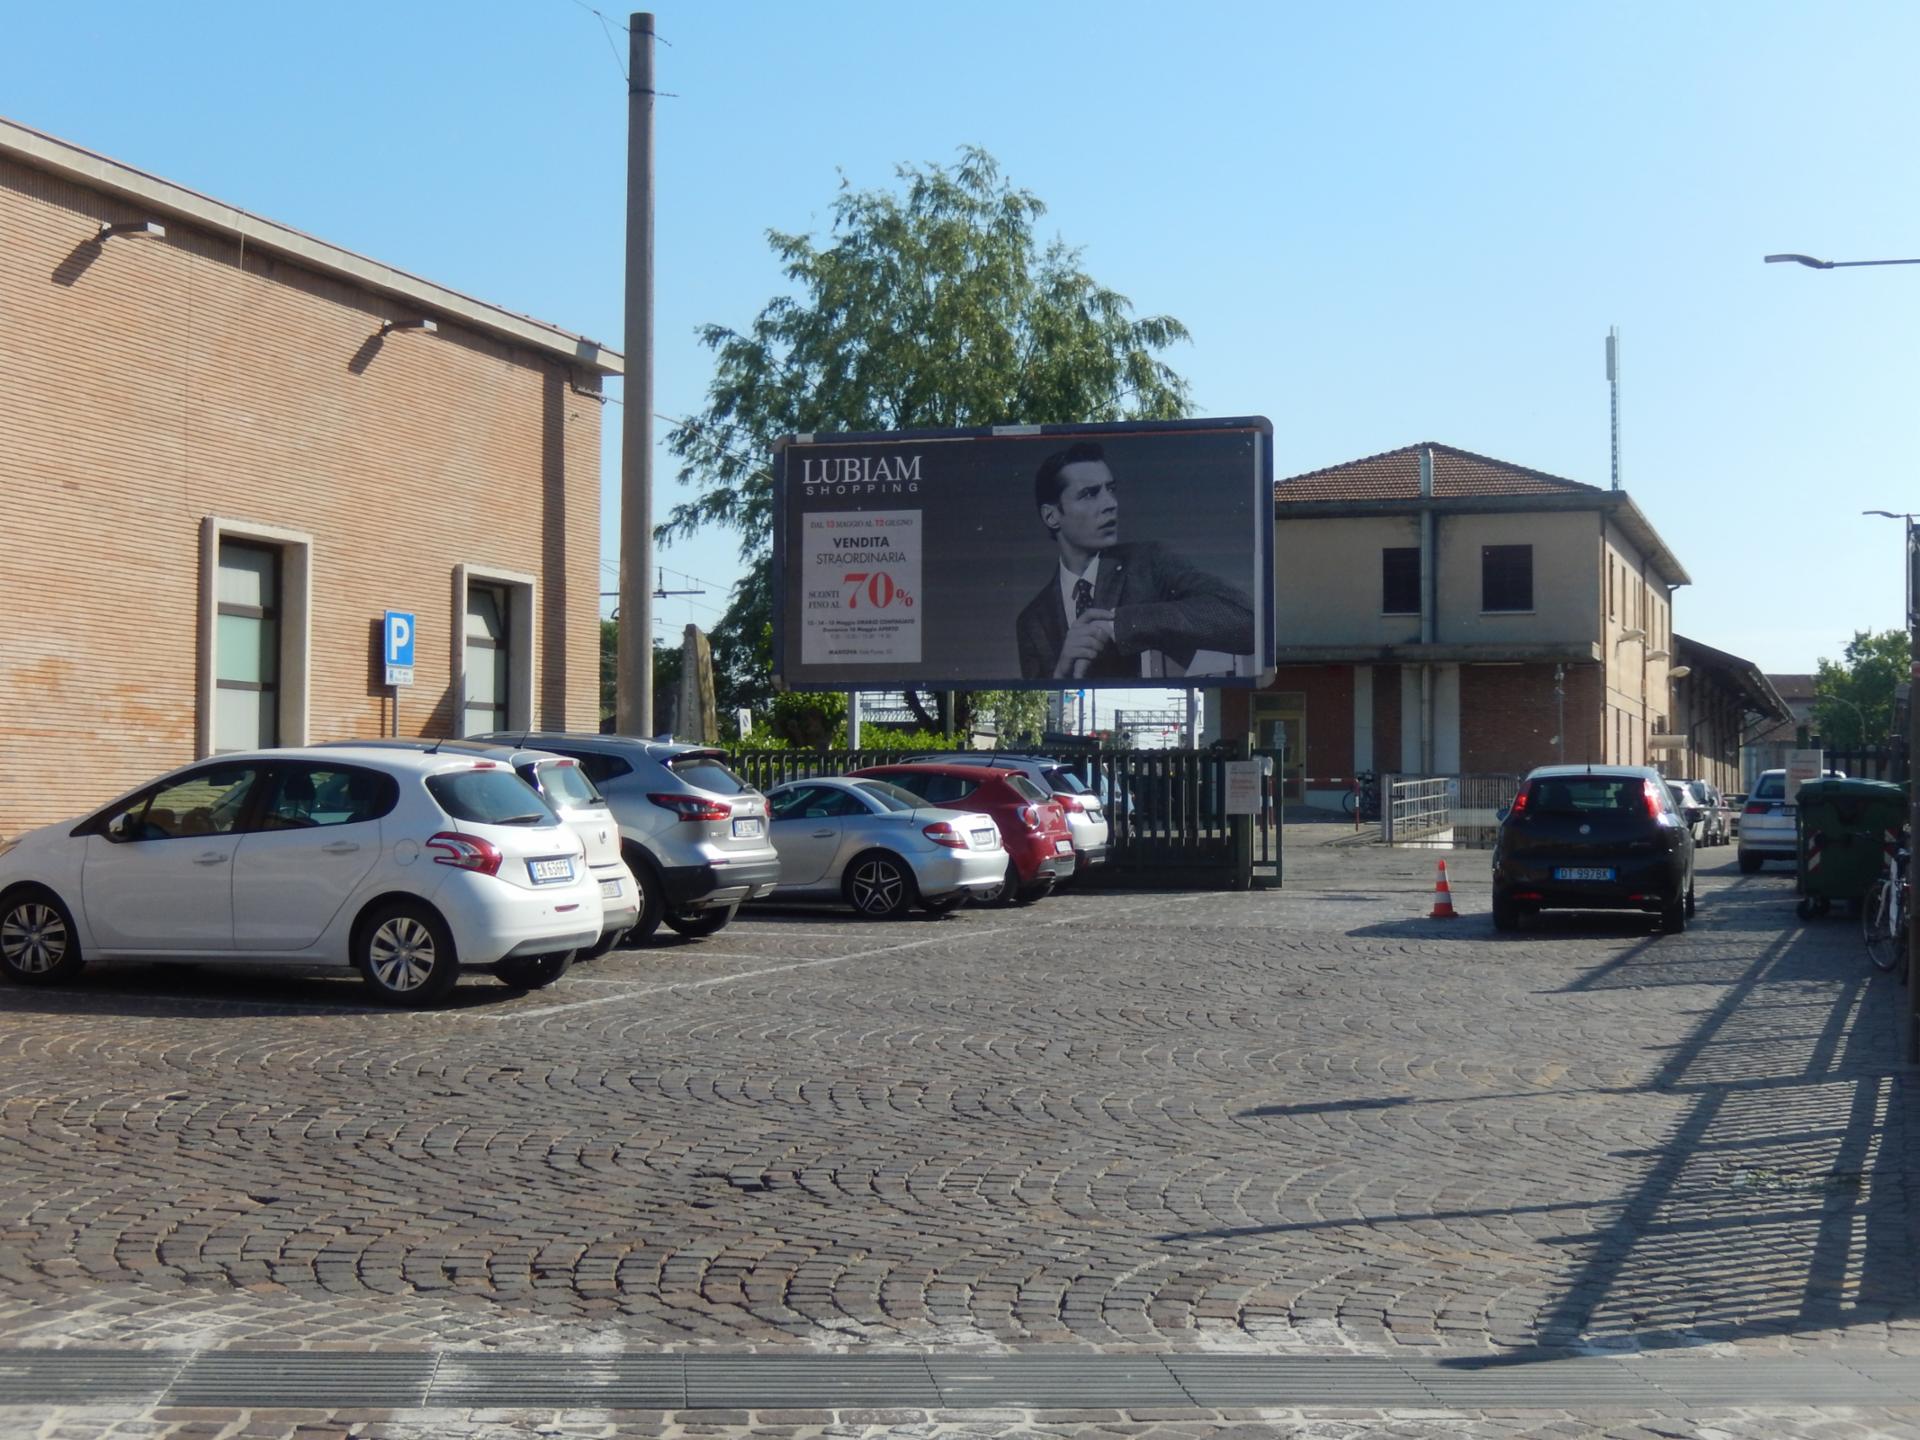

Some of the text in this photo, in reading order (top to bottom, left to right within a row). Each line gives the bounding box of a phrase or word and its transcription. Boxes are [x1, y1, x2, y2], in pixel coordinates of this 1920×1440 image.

[802, 455, 923, 484] LUBIAM
[806, 482, 919, 496] SHOPPING
[810, 521, 825, 529] DAL
[836, 520, 864, 528] MAGGIO
[885, 519, 913, 528] GIUGNO
[832, 536, 890, 549] VENDITA
[816, 551, 907, 565] STRAORDINARIA
[808, 590, 840, 599] SCONTI
[808, 601, 841, 609] FINO AL
[391, 617, 410, 660] P
